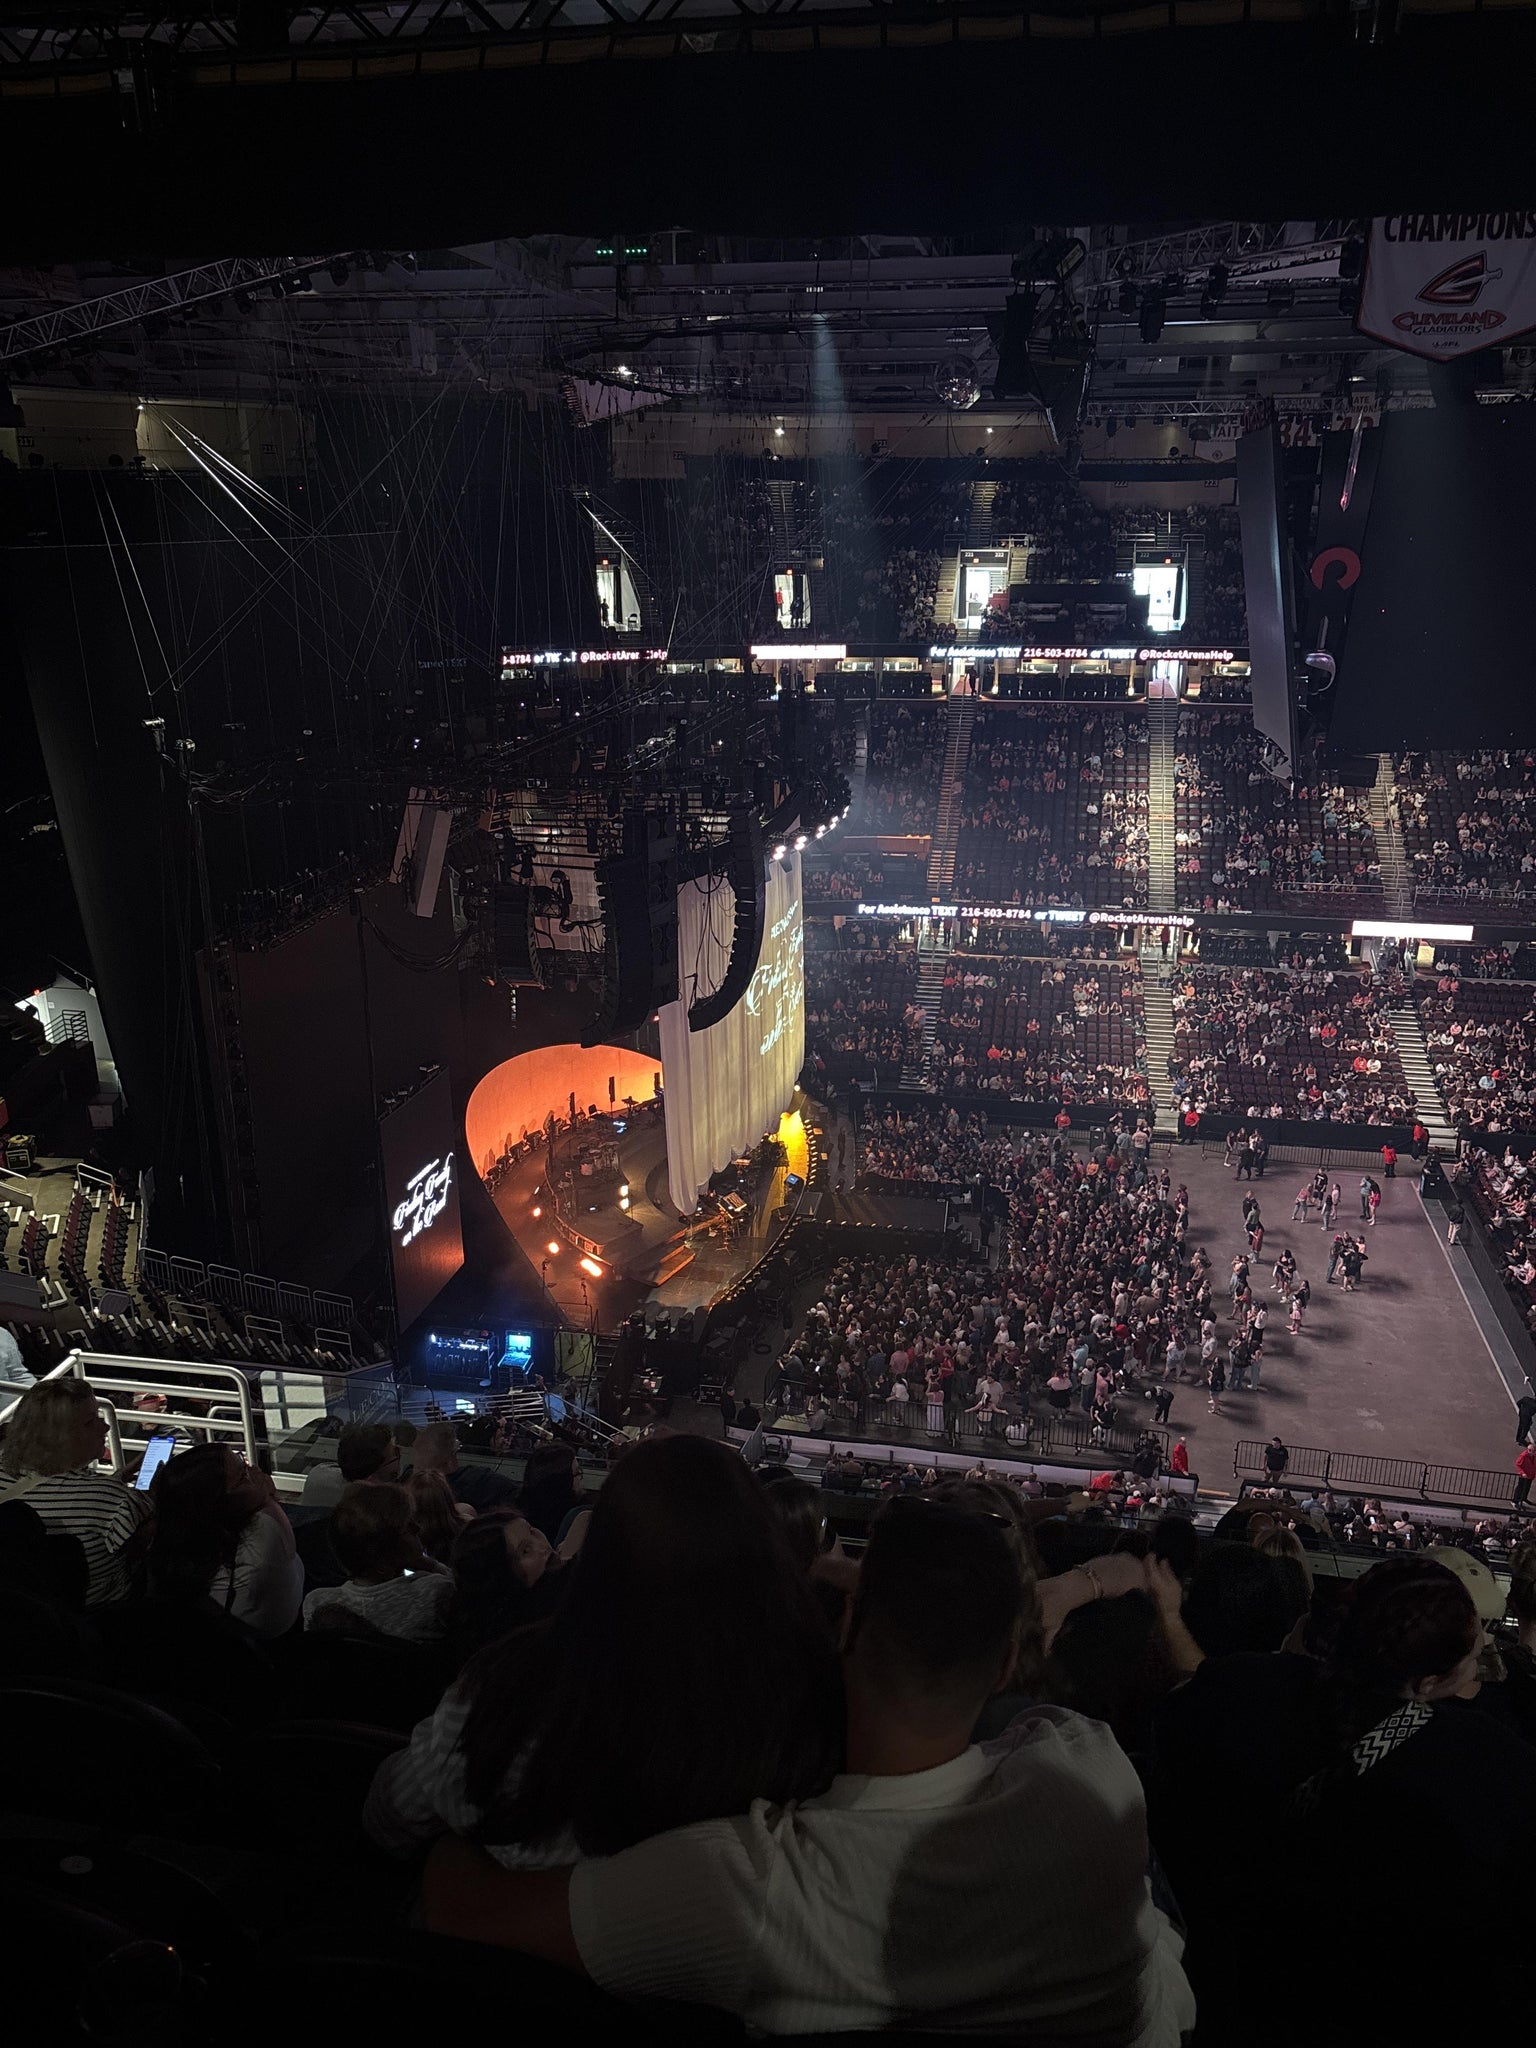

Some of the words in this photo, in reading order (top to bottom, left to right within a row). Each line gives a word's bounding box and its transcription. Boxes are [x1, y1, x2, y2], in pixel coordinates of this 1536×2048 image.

[1392, 309, 1507, 331] CLEVELAND
[1412, 324, 1483, 336] GLADIATORS
[930, 645, 946, 657] For
[997, 647, 1021, 659] TEXT
[1024, 647, 1087, 659] 216-503-8784
[1091, 650, 1103, 660] or
[1103, 648, 1136, 660] TWEET
[1139, 649, 1234, 662] @RocketArenaHelp
[858, 903, 876, 915] For
[877, 904, 931, 916] Assistance
[931, 905, 959, 917] TEXT
[961, 907, 1031, 920] 216-503-8784
[1034, 911, 1047, 920] or
[1048, 910, 1086, 922] TWEET
[1089, 912, 1195, 927] @RocketArenaHelp
